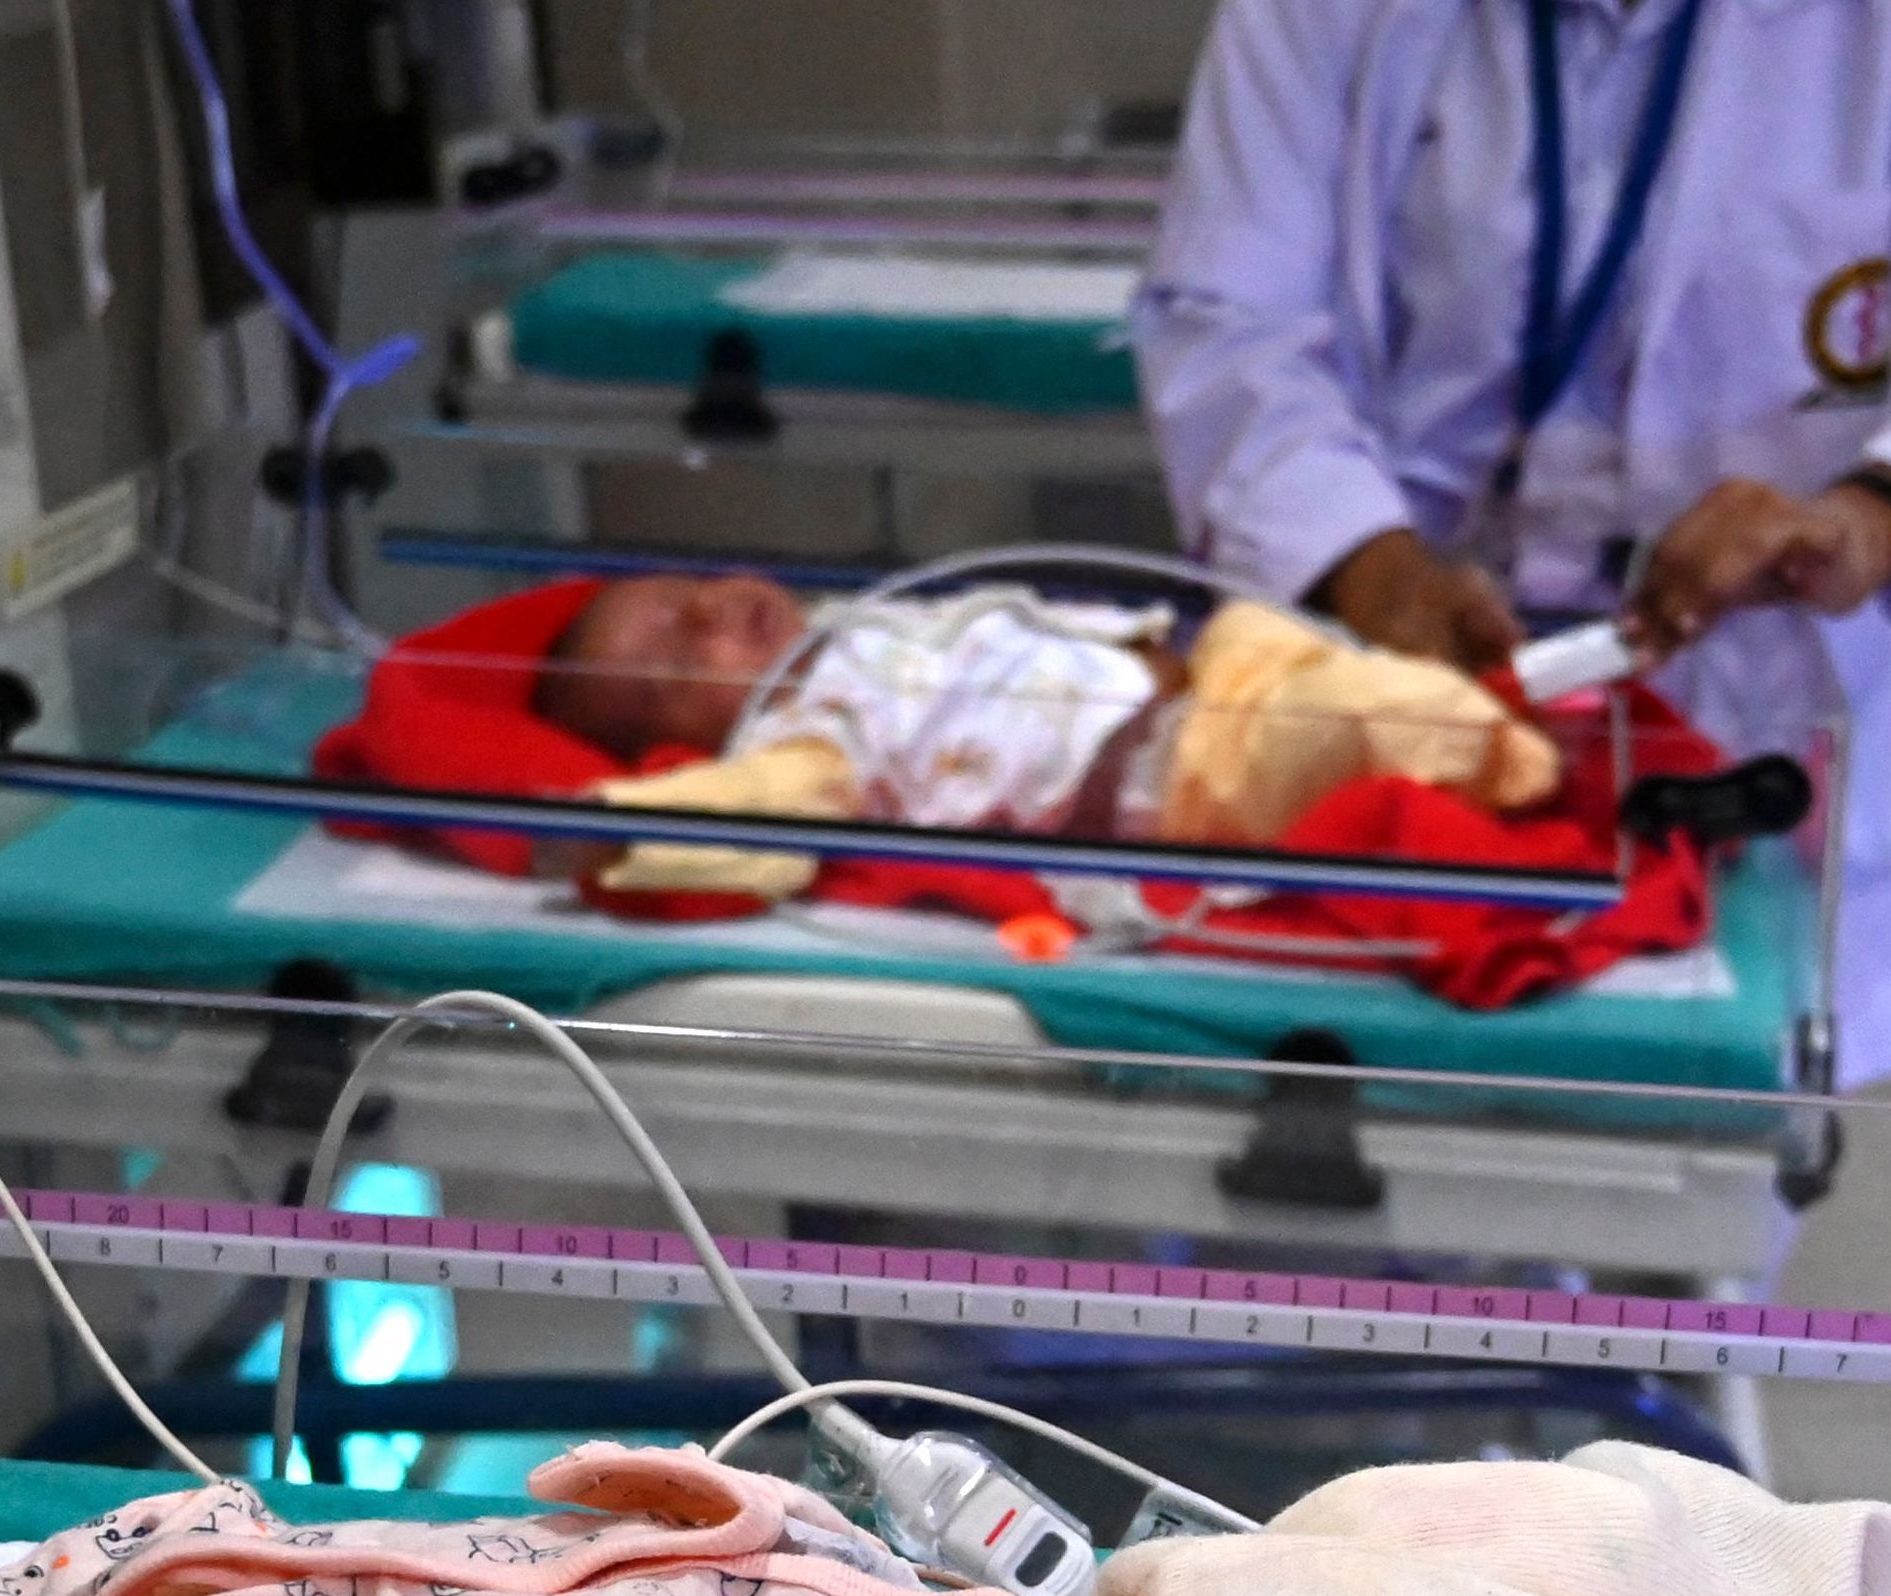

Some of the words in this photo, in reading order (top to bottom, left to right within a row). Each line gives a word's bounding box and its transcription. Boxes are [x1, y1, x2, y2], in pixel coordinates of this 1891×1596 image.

[99, 1237, 112, 1257] 8
[212, 1245, 225, 1264] 7
[325, 1252, 337, 1272] 6
[438, 1260, 451, 1280] 5
[551, 1268, 564, 1287] 4
[666, 1275, 679, 1296] 3
[782, 1283, 795, 1303] 2
[900, 1291, 909, 1310] 1
[1012, 1298, 1026, 1318] 0
[1132, 1307, 1141, 1327] 1
[1245, 1314, 1259, 1335] 2
[1362, 1322, 1376, 1343] 3
[1479, 1331, 1492, 1350] 4
[1597, 1337, 1611, 1359] 5
[1715, 1346, 1730, 1366] 6
[1836, 1353, 1848, 1373] 7
[107, 1205, 130, 1225] 20
[331, 1219, 353, 1240] 15
[557, 1235, 578, 1256] 10
[1014, 1264, 1027, 1286] 0
[1244, 1280, 1256, 1299] 5
[1473, 1295, 1494, 1317] 10
[1705, 1310, 1727, 1331] 15
